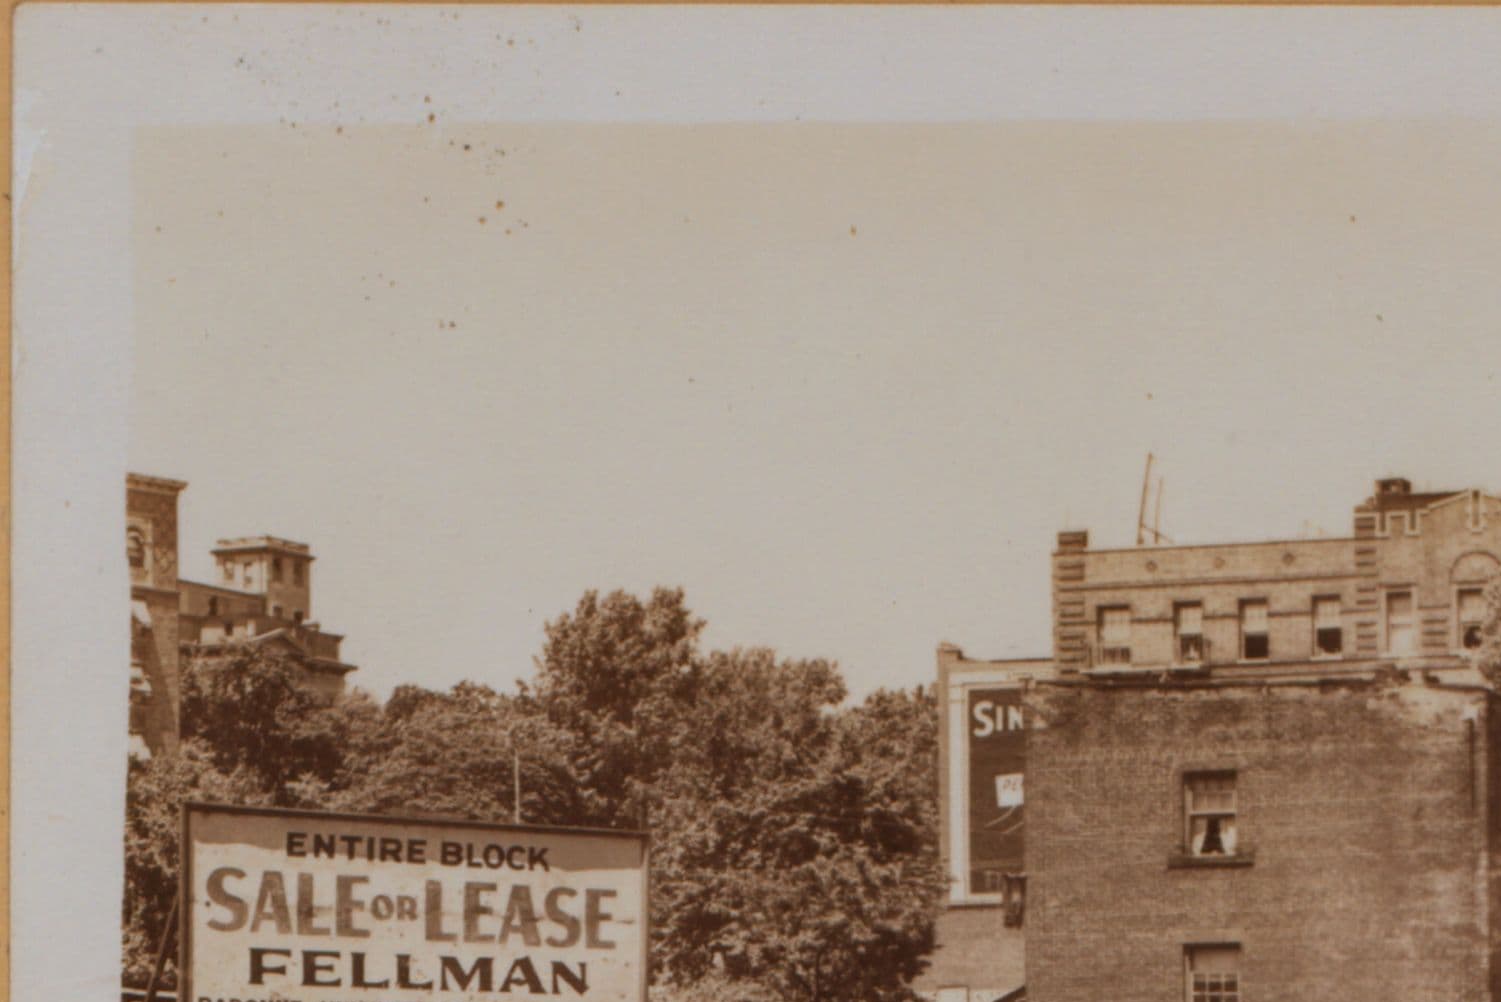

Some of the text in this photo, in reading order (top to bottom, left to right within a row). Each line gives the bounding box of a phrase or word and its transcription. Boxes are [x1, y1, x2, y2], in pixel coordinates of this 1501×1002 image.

[286, 831, 550, 872] ENTIRE BLOCK
[205, 866, 617, 949] SALE OR LEASE
[248, 947, 590, 996] FELLMAN
